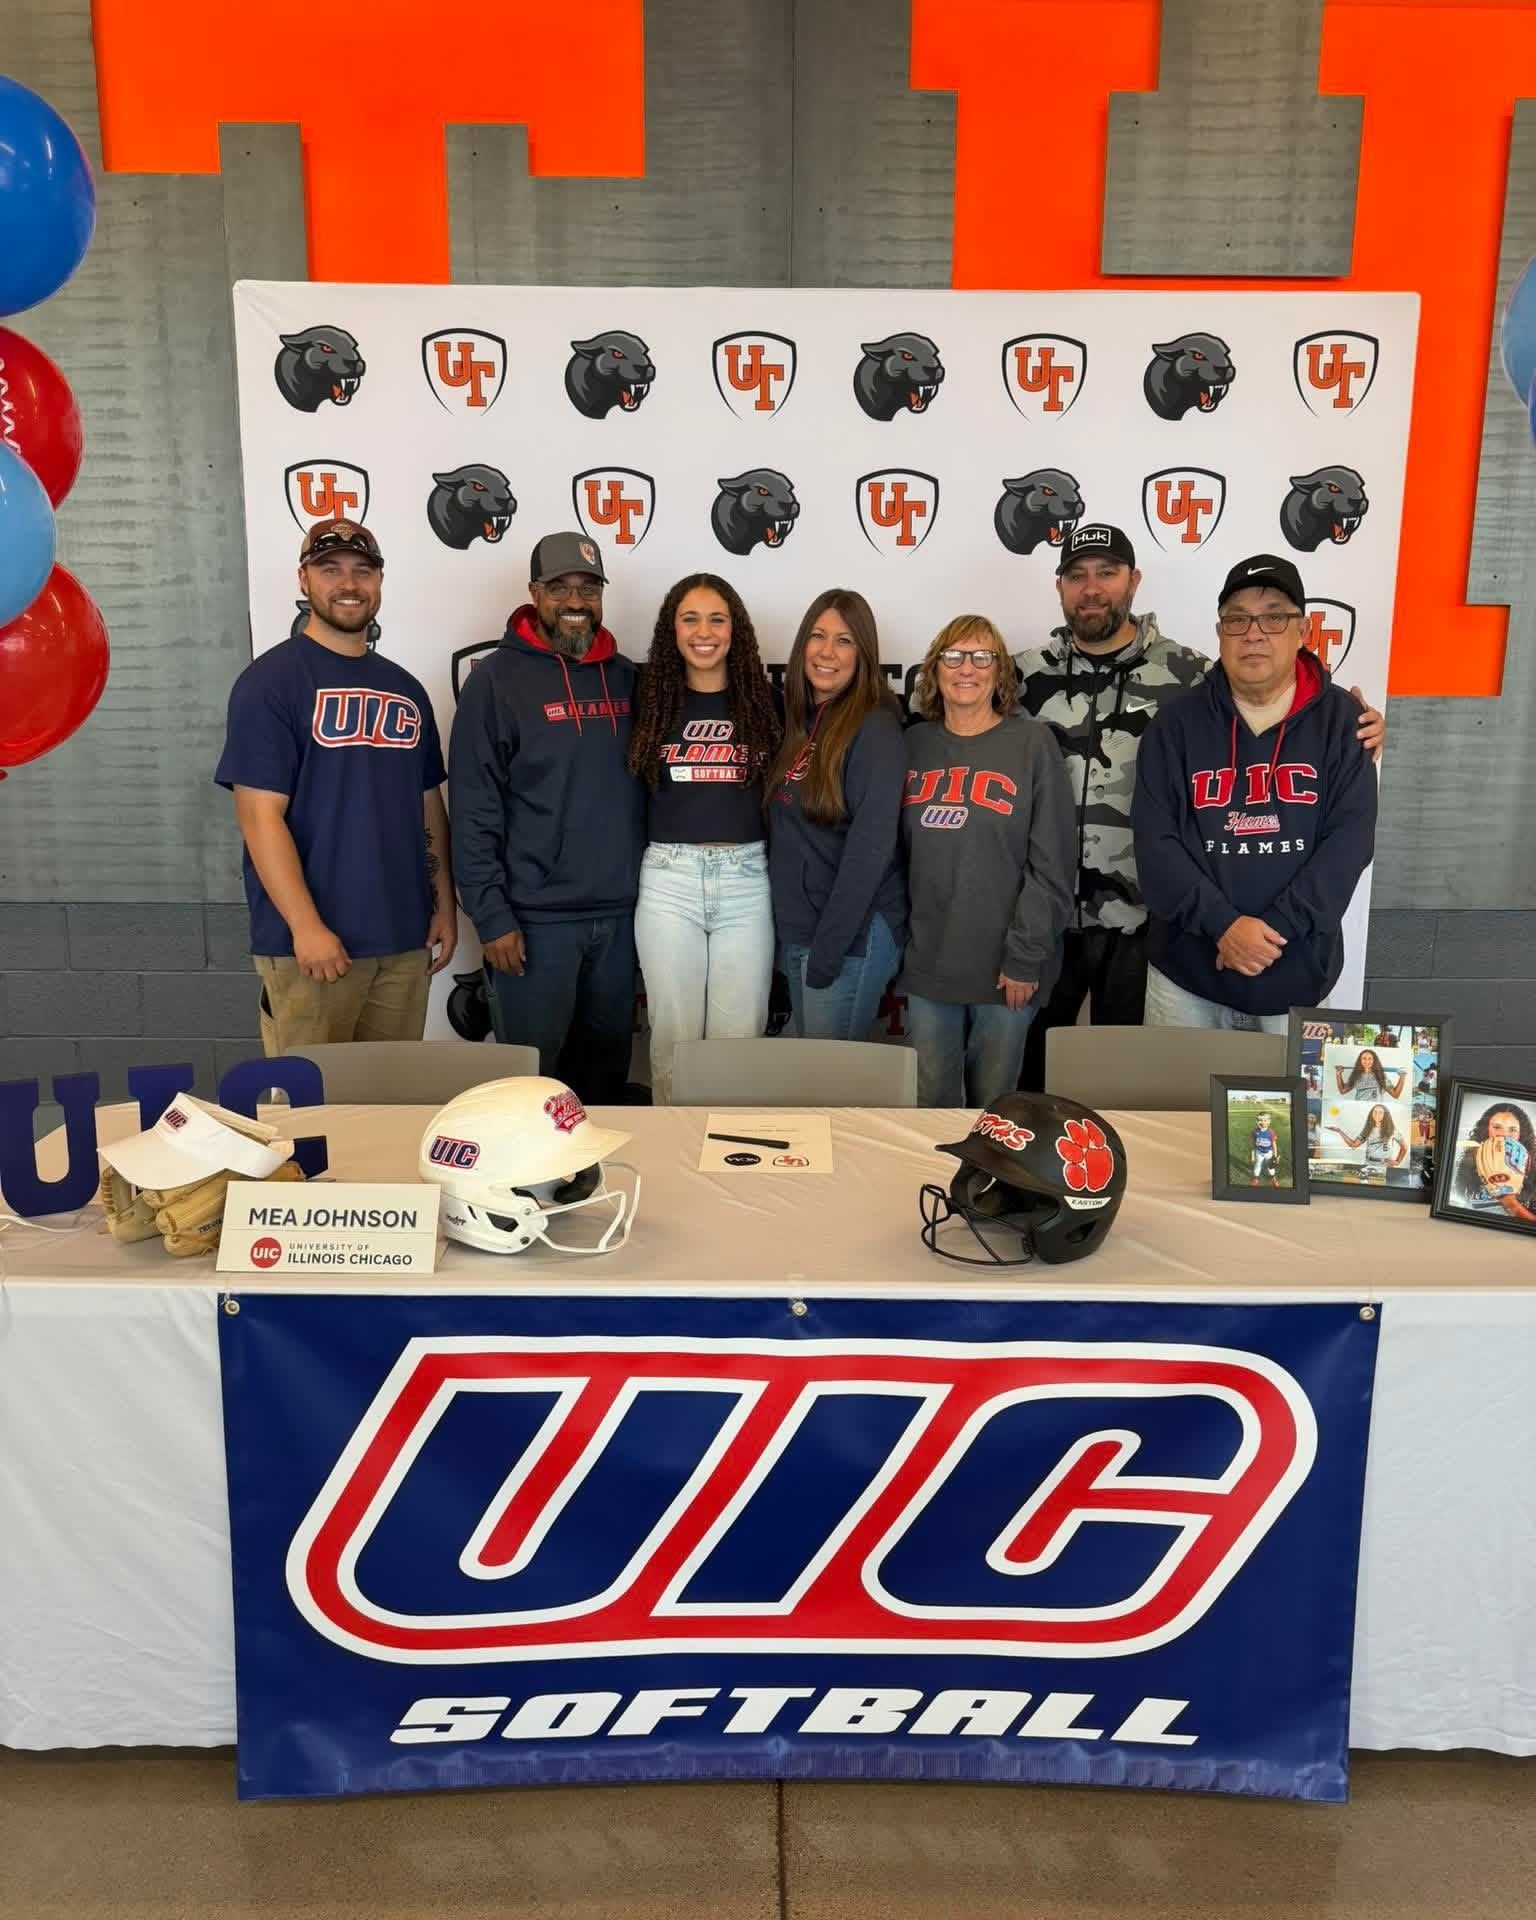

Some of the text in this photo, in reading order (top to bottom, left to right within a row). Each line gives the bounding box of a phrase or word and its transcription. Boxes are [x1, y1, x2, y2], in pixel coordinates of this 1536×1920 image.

[434, 341, 495, 407] UT
[724, 344, 785, 411] UT
[1014, 346, 1074, 412] UT
[1306, 343, 1366, 408] UT
[584, 480, 644, 545] UT
[868, 482, 926, 546] UT
[1154, 480, 1213, 544] UT
[312, 688, 421, 749] UIC
[682, 720, 734, 741] UIC
[693, 769, 743, 779] SOFTBAL
[901, 767, 1017, 815] UIC
[1192, 763, 1318, 808] UIC
[920, 805, 969, 829] UIC
[1206, 839, 1305, 854] FLAMES
[164, 1107, 190, 1131] UIC
[429, 1135, 481, 1169] UIC
[248, 1207, 417, 1228] MEA JOHNSON
[252, 1245, 280, 1260] UIC
[287, 1253, 413, 1266] ILLINOIS CHICAGO
[286, 1336, 1318, 1664] UIC
[390, 1686, 1199, 1747] SOFTBALL
